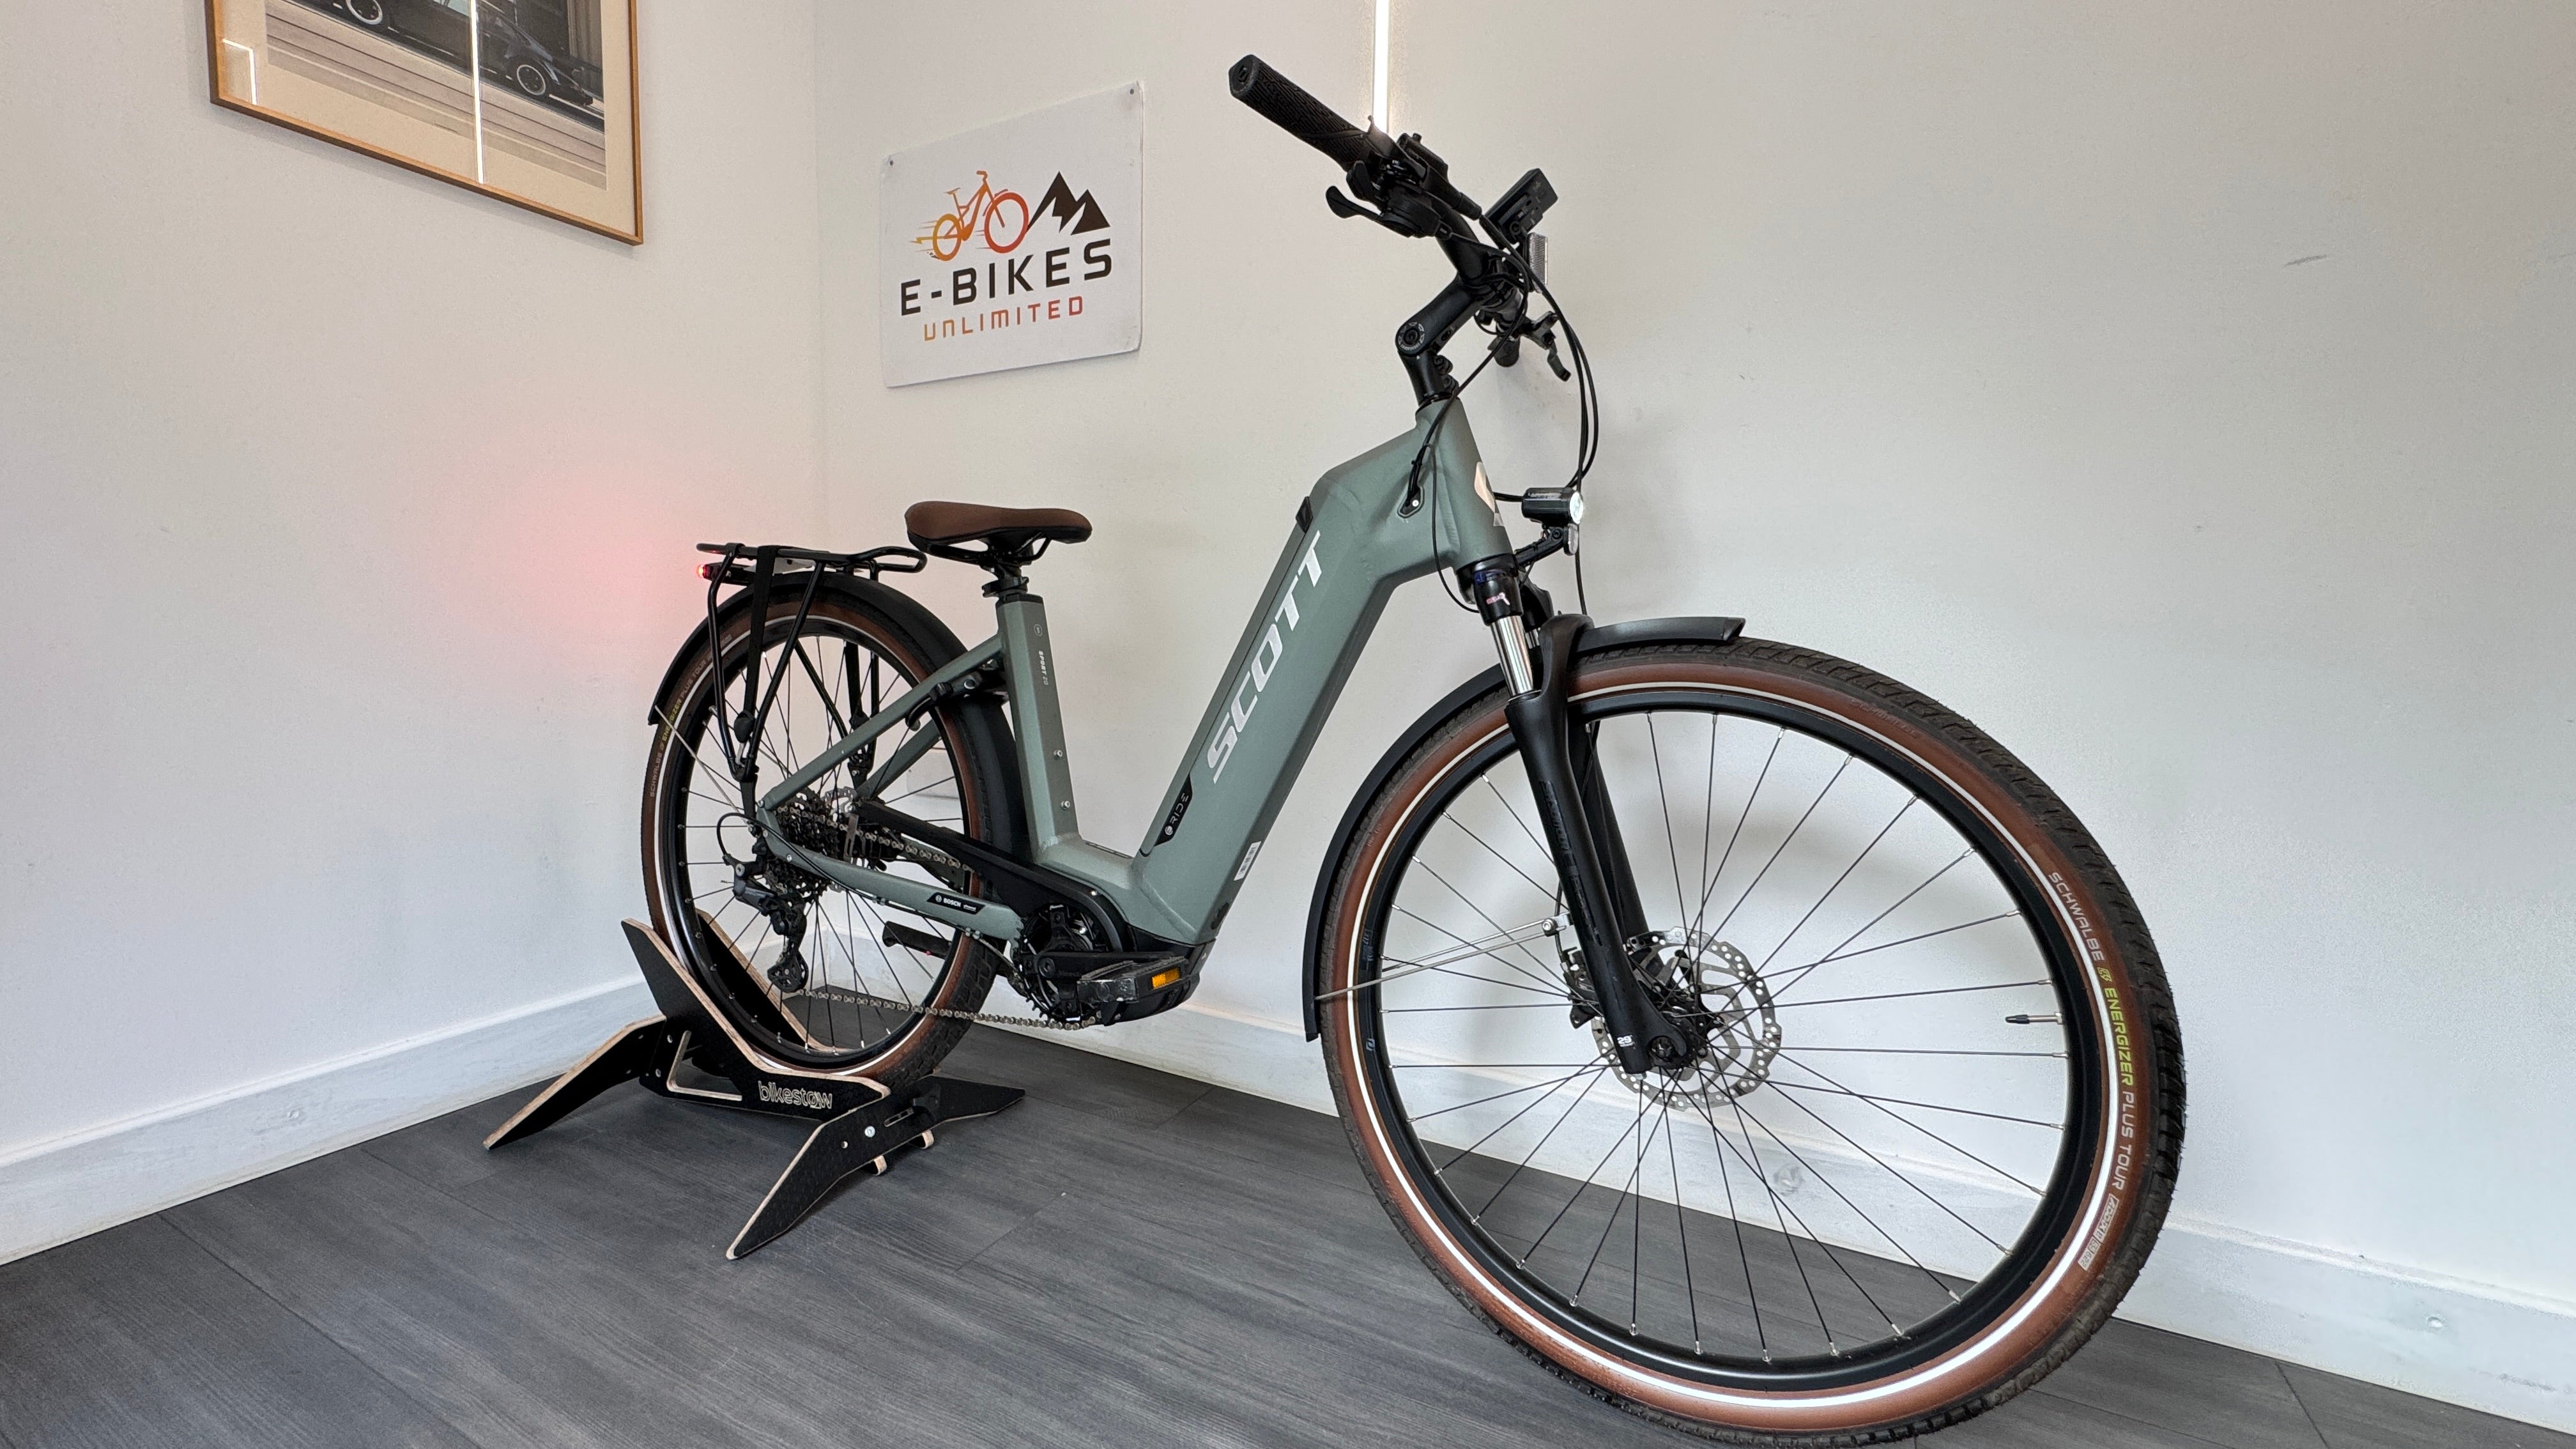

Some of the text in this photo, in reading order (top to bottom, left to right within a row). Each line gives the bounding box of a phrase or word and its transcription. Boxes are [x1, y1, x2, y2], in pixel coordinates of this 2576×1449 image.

[901, 238, 1112, 316] E-BIKES
[924, 296, 1083, 341] UNLIMITED
[1038, 650, 1047, 675] SPORT
[1208, 530, 1322, 784] SCOTT
[650, 752, 663, 797] SCHWALBE
[681, 679, 693, 699] PLUS
[943, 898, 962, 907] BOSCH
[2048, 872, 2104, 961] SCHWALBE
[2104, 988, 2133, 1085] ENERGIZER
[758, 1080, 832, 1109] bikestow
[2121, 1091, 2135, 1138] PLUS
[2112, 1144, 2132, 1190] TOUR
